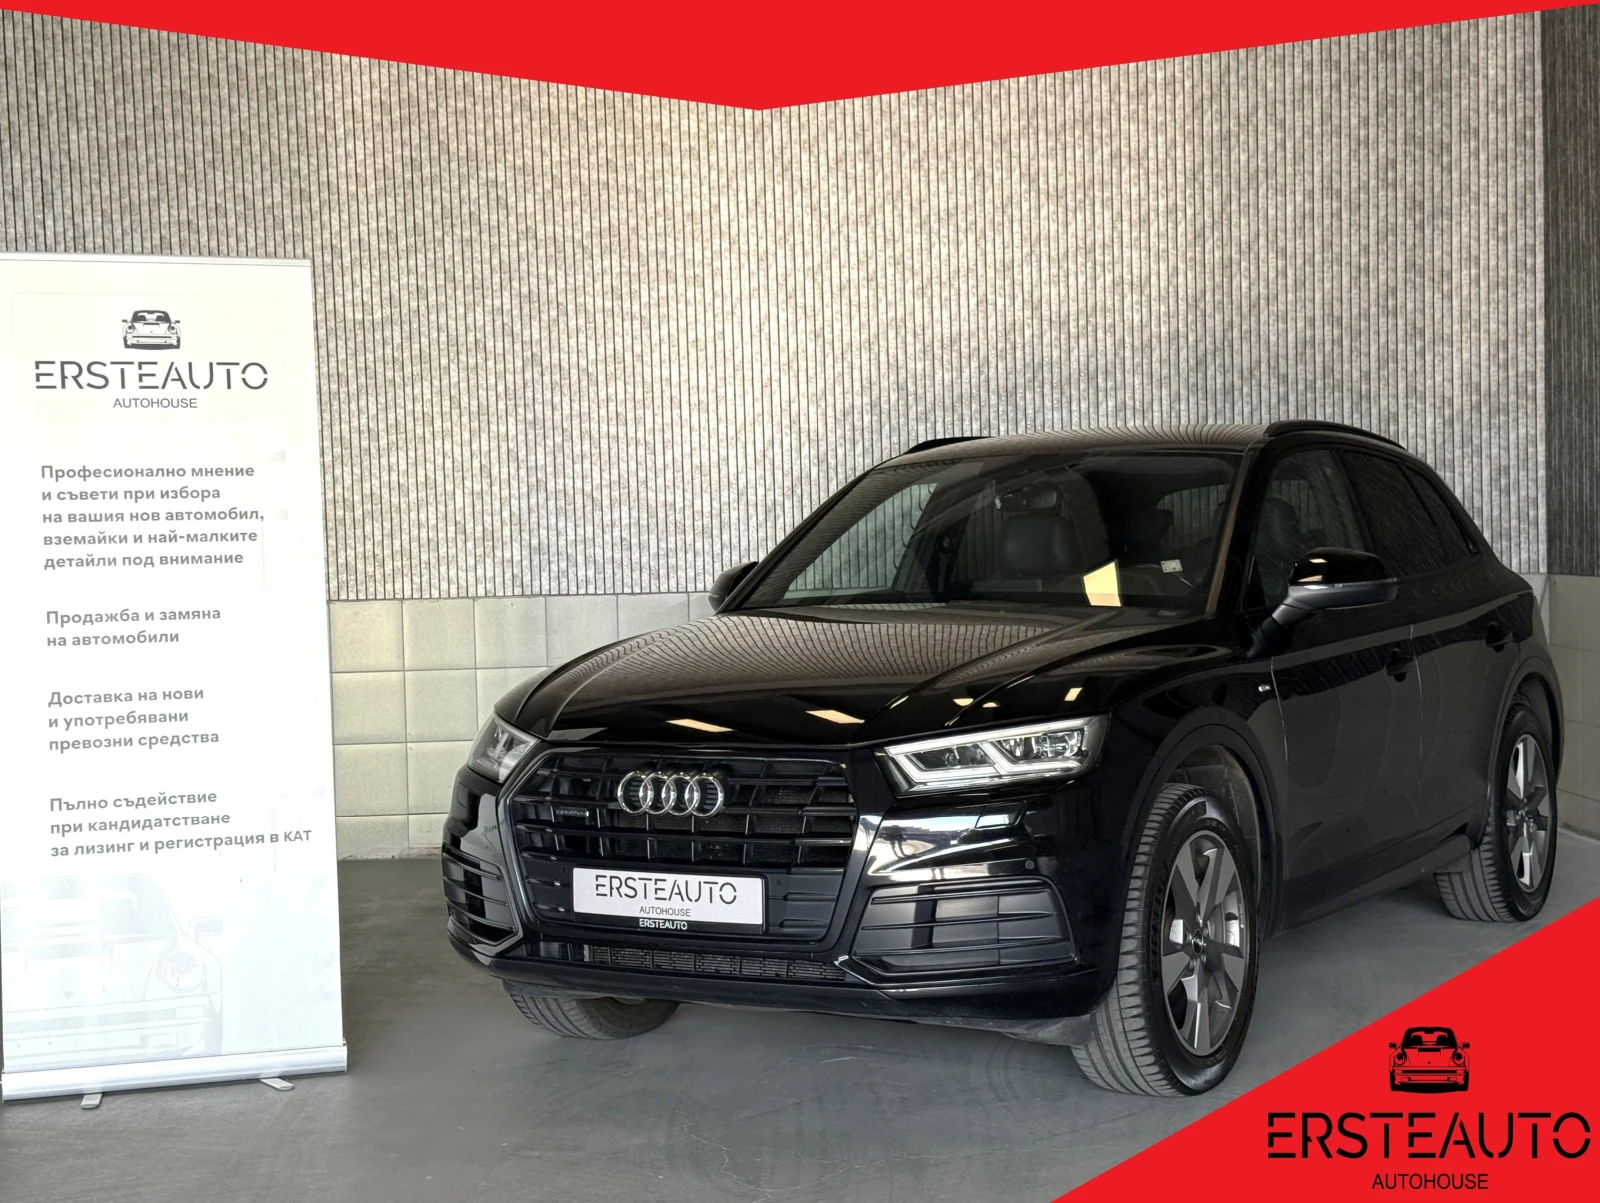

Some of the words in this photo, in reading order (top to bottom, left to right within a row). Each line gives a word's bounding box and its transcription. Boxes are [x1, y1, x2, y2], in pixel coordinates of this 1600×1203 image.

[35, 361, 268, 390] ERSTEAUTO
[113, 398, 198, 408] AUTOHOUSE
[41, 465, 186, 482] Професионално
[191, 467, 255, 477] мнение
[42, 492, 51, 501] и
[57, 491, 118, 500] съвети
[124, 490, 155, 503] при
[160, 486, 220, 501] избора
[43, 513, 62, 523] на
[68, 513, 124, 523] вашия
[130, 512, 160, 521] нов
[165, 507, 264, 522] автомобил,
[44, 531, 128, 545] вземайки
[133, 534, 143, 543] и
[148, 529, 257, 543] най-малките
[44, 554, 117, 570] детайли
[122, 556, 155, 568] под
[160, 554, 243, 565] внимание
[47, 608, 139, 628] Продажба
[145, 612, 154, 621] и
[159, 610, 220, 620] замяна
[47, 637, 67, 646] на
[72, 630, 179, 646] автомобили
[48, 692, 133, 708] Доставка
[138, 692, 157, 701] на
[163, 690, 203, 700] нови
[49, 718, 58, 728] и
[63, 711, 188, 731] употребявани
[49, 737, 133, 754] превозни
[138, 733, 219, 750] средства
[50, 798, 108, 811] Пълно
[113, 792, 217, 809] съдействие
[51, 823, 82, 837] при
[88, 815, 230, 832] кандидатстване
[51, 847, 69, 857] за
[74, 842, 135, 855] лизинг
[140, 841, 149, 851] и
[155, 834, 265, 854] регистрация
[270, 834, 279, 843] в
[284, 830, 312, 842] КАТ
[595, 874, 738, 905] ERSTEAUTO
[639, 906, 691, 917] AUTOHOUSE
[639, 918, 688, 930] ERSTEAUTO
